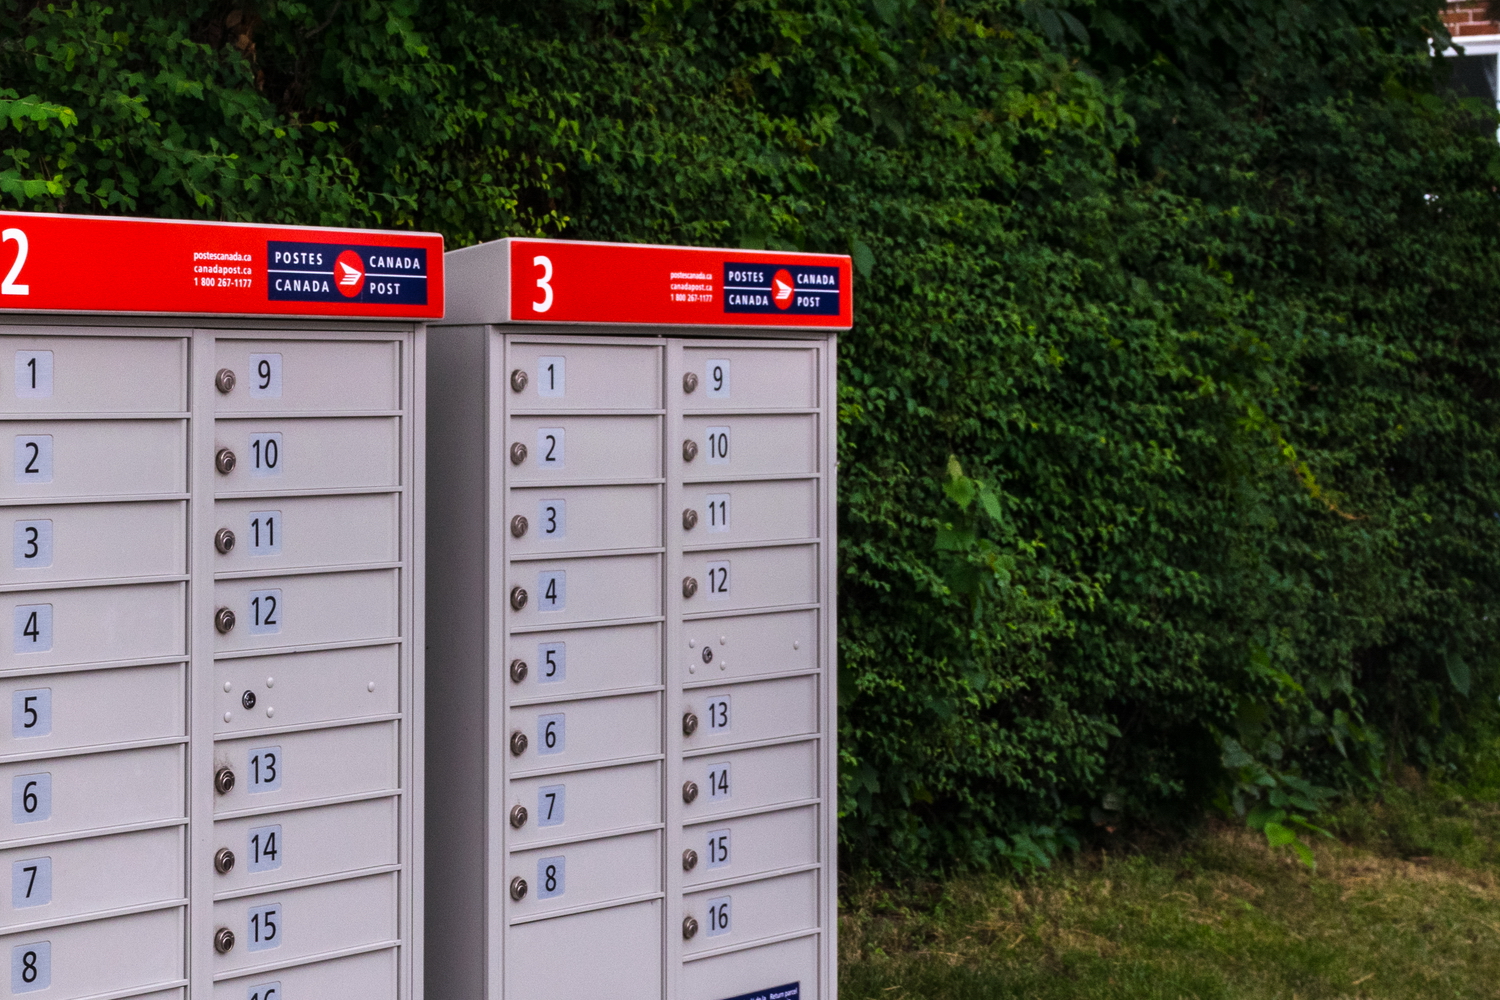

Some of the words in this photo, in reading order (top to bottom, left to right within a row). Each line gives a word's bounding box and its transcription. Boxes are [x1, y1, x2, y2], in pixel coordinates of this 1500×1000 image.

[1, 228, 29, 296] 2
[193, 252, 252, 262] postescanada.ca
[194, 264, 252, 276] canadapost.ca
[275, 251, 323, 265] POSTES
[369, 256, 420, 269] CANADA
[201, 277, 215, 287] 800
[217, 278, 252, 288] 267-1177
[275, 279, 329, 292] CANADA
[370, 282, 400, 295] POST
[532, 255, 554, 313] 3
[670, 272, 713, 280] postescanada.ca
[670, 283, 713, 292] canadapost.ca
[728, 271, 764, 283] POSTES
[797, 273, 835, 285] CANADA
[675, 293, 686, 302] 800
[687, 294, 713, 302] 267-1177
[729, 294, 768, 306] CANADA
[797, 296, 820, 307] POST
[27, 358, 36, 389] 1
[258, 359, 271, 390] 9
[547, 363, 554, 390] 1
[713, 366, 723, 391] 9
[25, 442, 39, 474] 2
[252, 439, 278, 469] 10
[545, 435, 556, 462] 2
[709, 433, 728, 458] 10
[546, 506, 556, 534] 3
[709, 501, 726, 526] 11
[24, 526, 38, 559] 3
[251, 517, 273, 547] 11
[545, 578, 557, 605] 4
[708, 567, 728, 593] 12
[251, 595, 277, 626] 12
[23, 611, 40, 642] 4
[546, 650, 556, 677] 5
[24, 696, 38, 728] 5
[709, 701, 728, 728] 13
[545, 721, 556, 749] 6
[251, 753, 276, 784] 13
[709, 769, 729, 796] 14
[23, 781, 38, 813] 6
[545, 792, 556, 820] 7
[251, 832, 277, 863] 14
[708, 836, 728, 863] 15
[23, 866, 37, 898] 7
[545, 864, 557, 892] 8
[251, 910, 276, 943] 15
[709, 903, 728, 931] 16
[22, 951, 37, 983] 8
